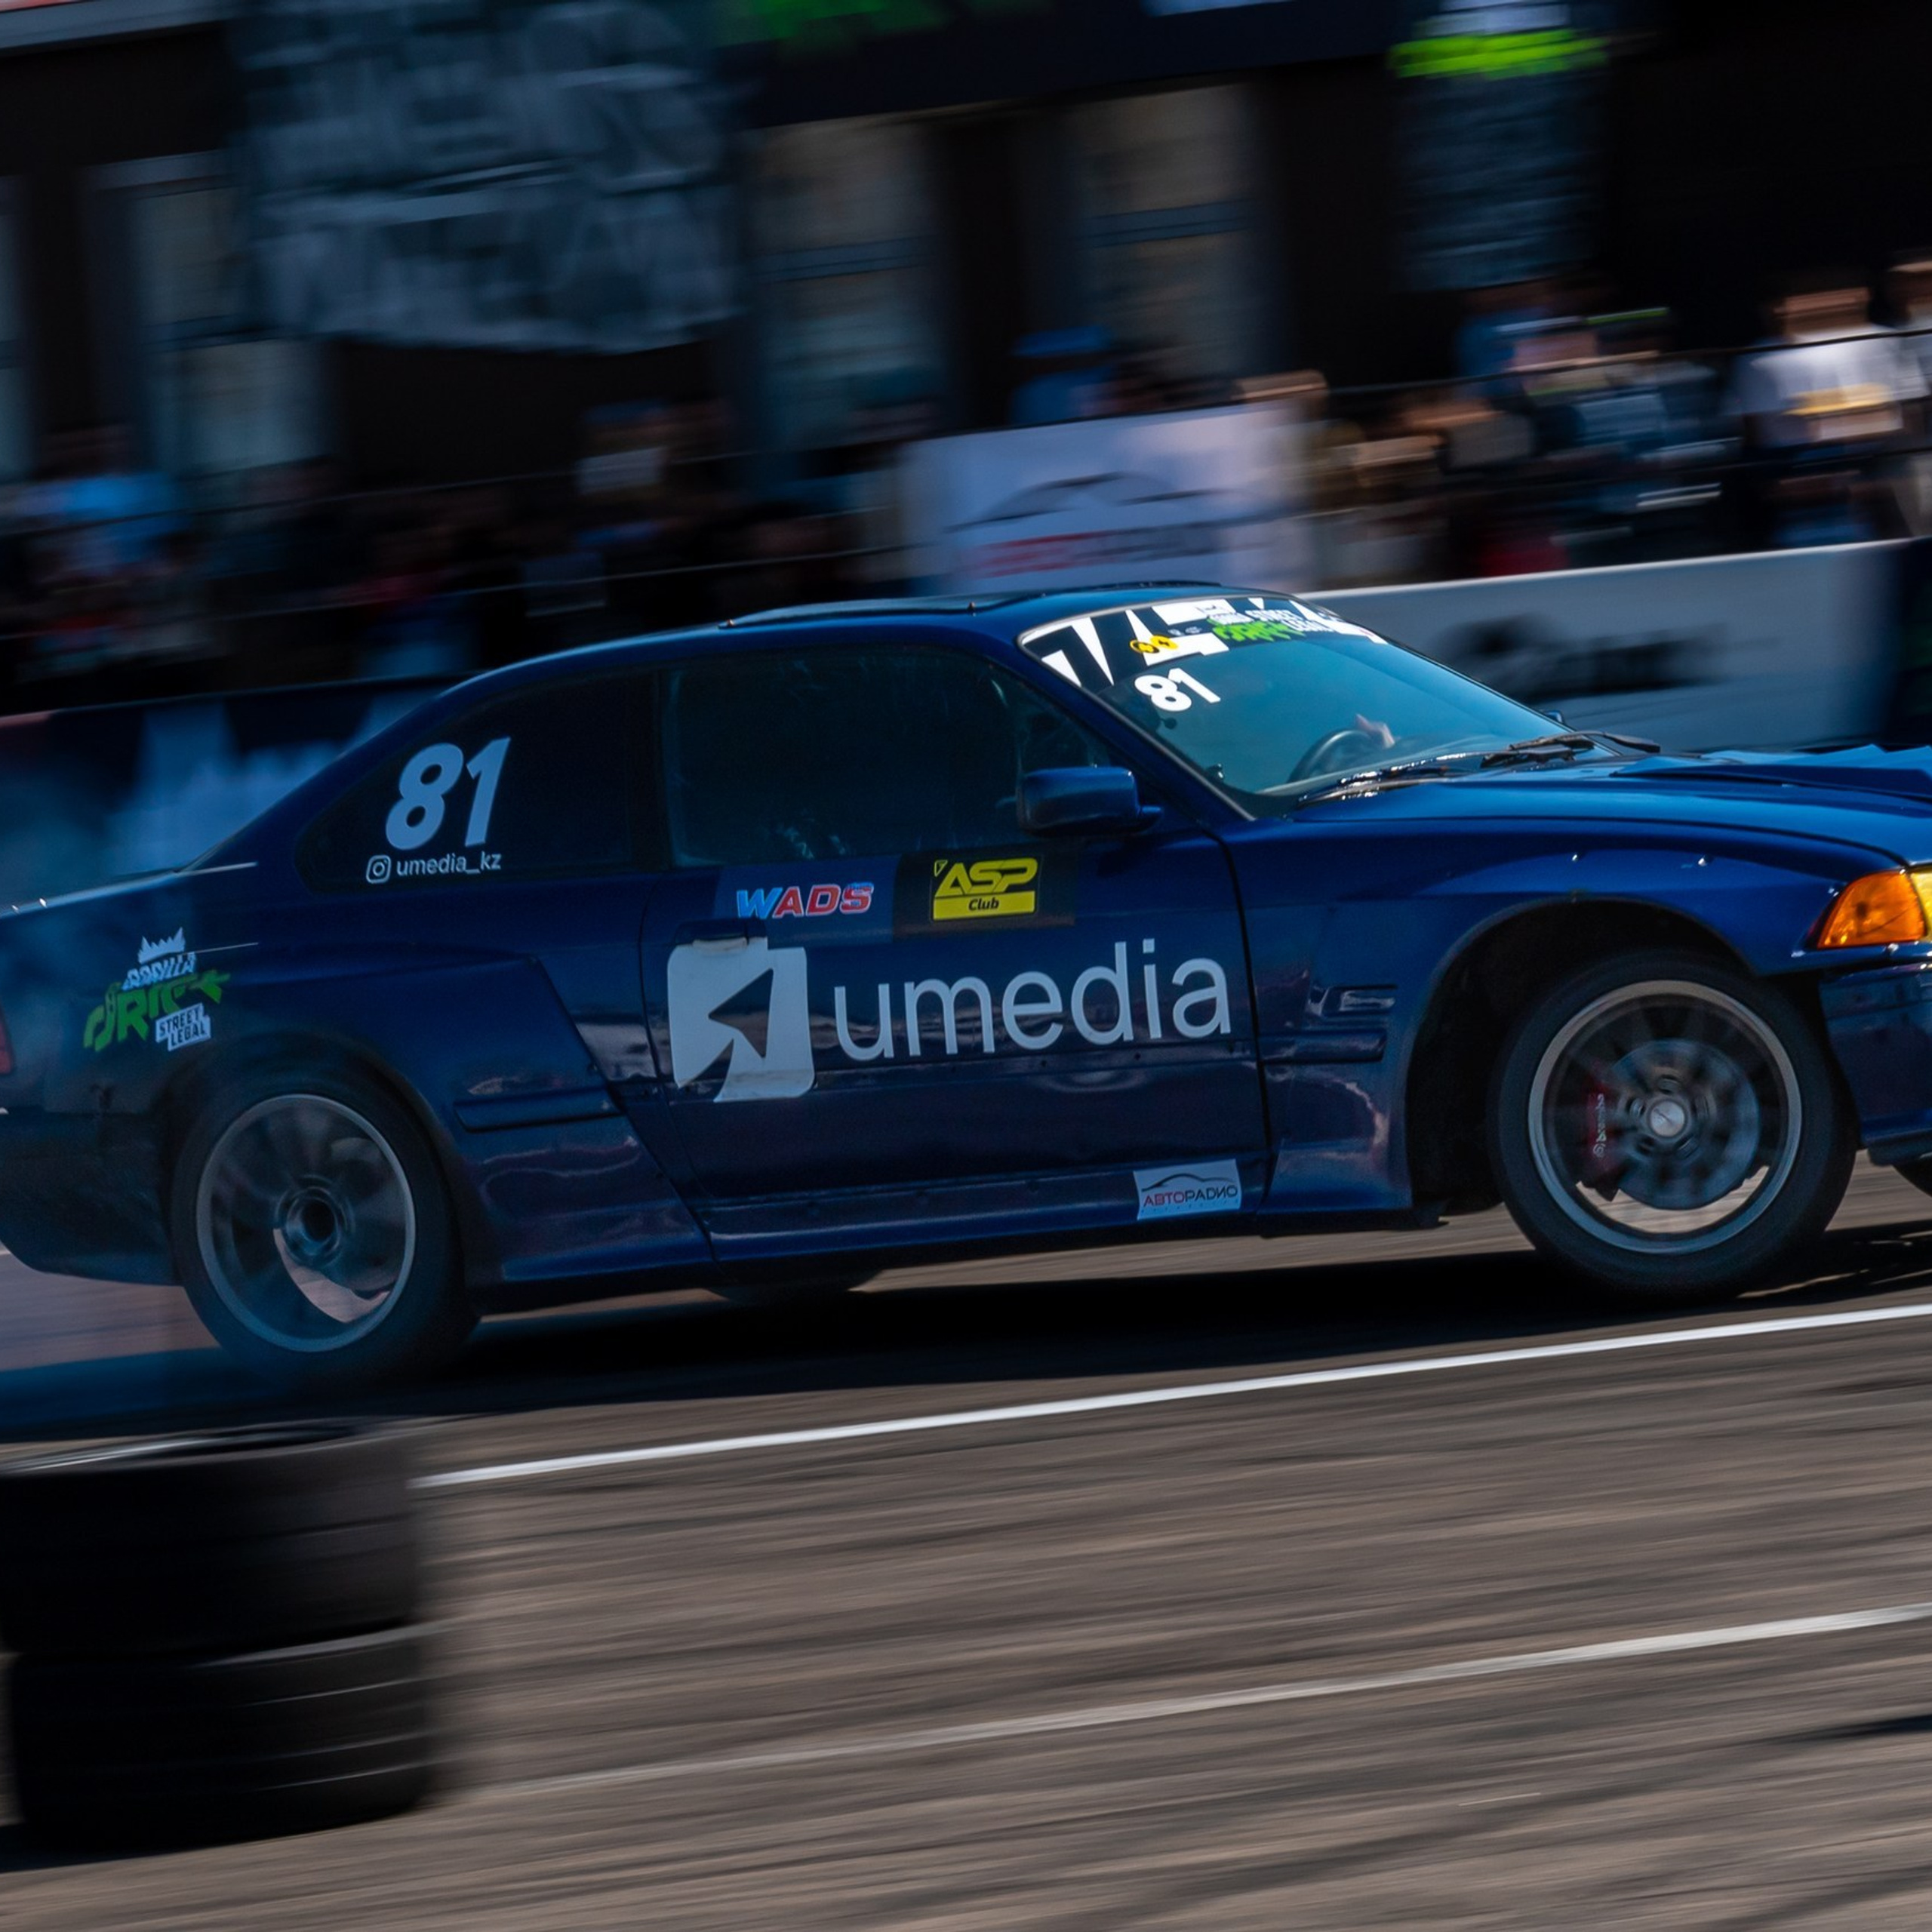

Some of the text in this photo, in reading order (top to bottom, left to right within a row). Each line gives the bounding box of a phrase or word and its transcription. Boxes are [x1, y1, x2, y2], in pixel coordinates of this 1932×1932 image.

[1134, 668, 1220, 712] 81
[385, 737, 512, 851] 81
[396, 851, 502, 877] umedia_kz
[935, 857, 1038, 897] ASP
[735, 881, 875, 919] WADS
[968, 897, 1000, 911] Club
[833, 938, 1231, 1060] umedia
[159, 1006, 198, 1038] STREET
[171, 1020, 207, 1047] LEGAL
